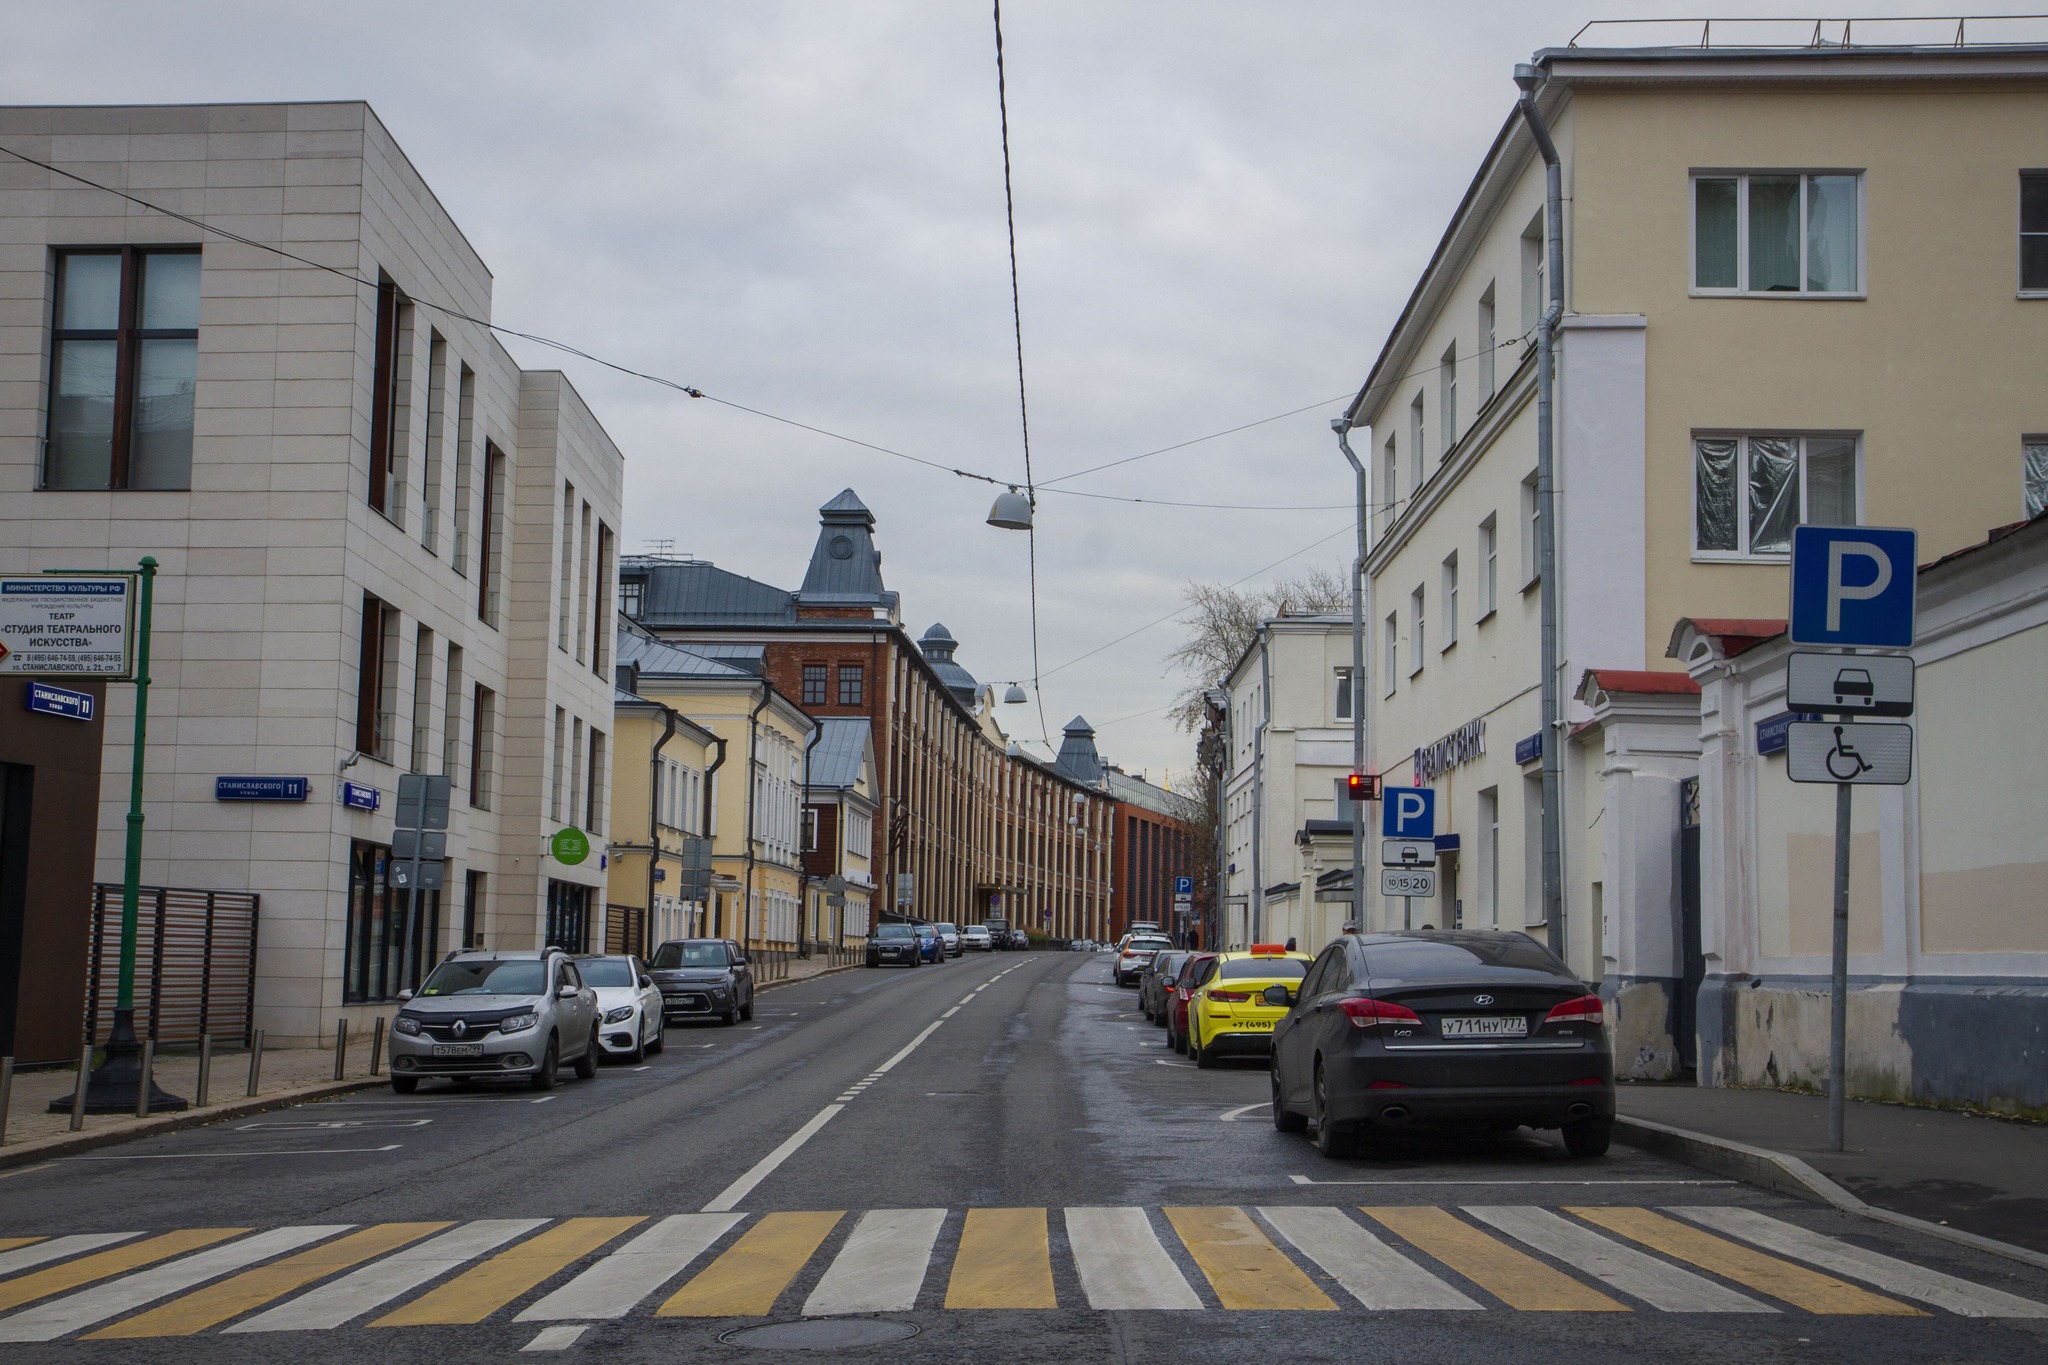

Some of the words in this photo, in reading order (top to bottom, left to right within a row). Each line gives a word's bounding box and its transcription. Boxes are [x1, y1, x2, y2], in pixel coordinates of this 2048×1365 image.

[6, 584, 66, 592] МИНИСТЕРСТВО
[1826, 541, 1893, 631] P
[47, 625, 122, 634] ТЕАТРАЛЬНОГО
[32, 654, 46, 663] (495)
[78, 655, 92, 663] (495)
[34, 689, 79, 706] СТАНИСЛАВСКОГО
[82, 700, 90, 714] 11
[1457, 719, 1486, 766] БАНК
[218, 782, 281, 790] СТАНИСЛАВСКОГО
[288, 783, 298, 794] 11
[1396, 792, 1426, 832] P
[1180, 878, 1189, 892] P
[1388, 878, 1396, 887] 10
[1399, 878, 1409, 888] 15
[1412, 878, 1428, 889] 20
[1245, 1020, 1272, 1029] (495)
[1502, 1017, 1523, 1028] 777
